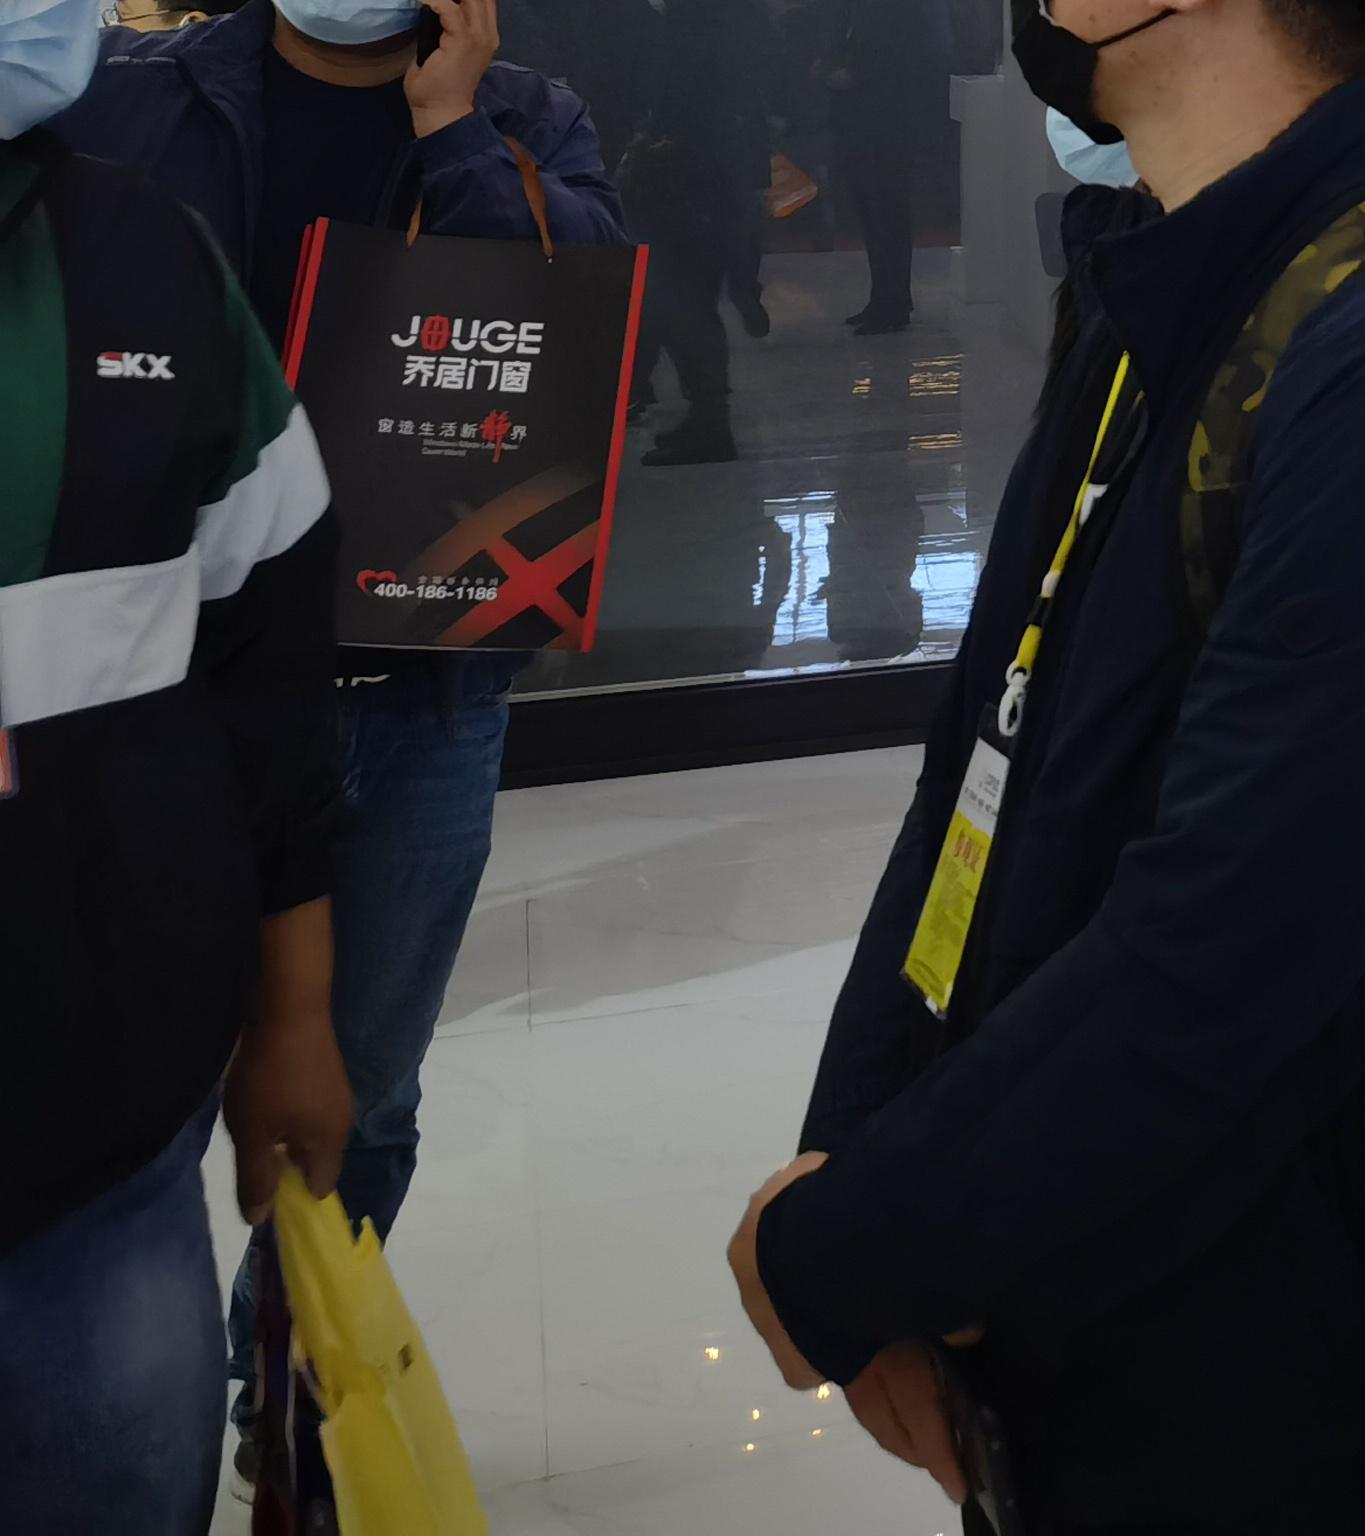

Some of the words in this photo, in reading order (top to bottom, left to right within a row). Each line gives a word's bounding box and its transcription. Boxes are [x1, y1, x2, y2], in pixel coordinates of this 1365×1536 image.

[97, 351, 176, 380] SKX
[402, 355, 532, 393] 乔居门窗
[374, 582, 498, 601] 400-186-1186
